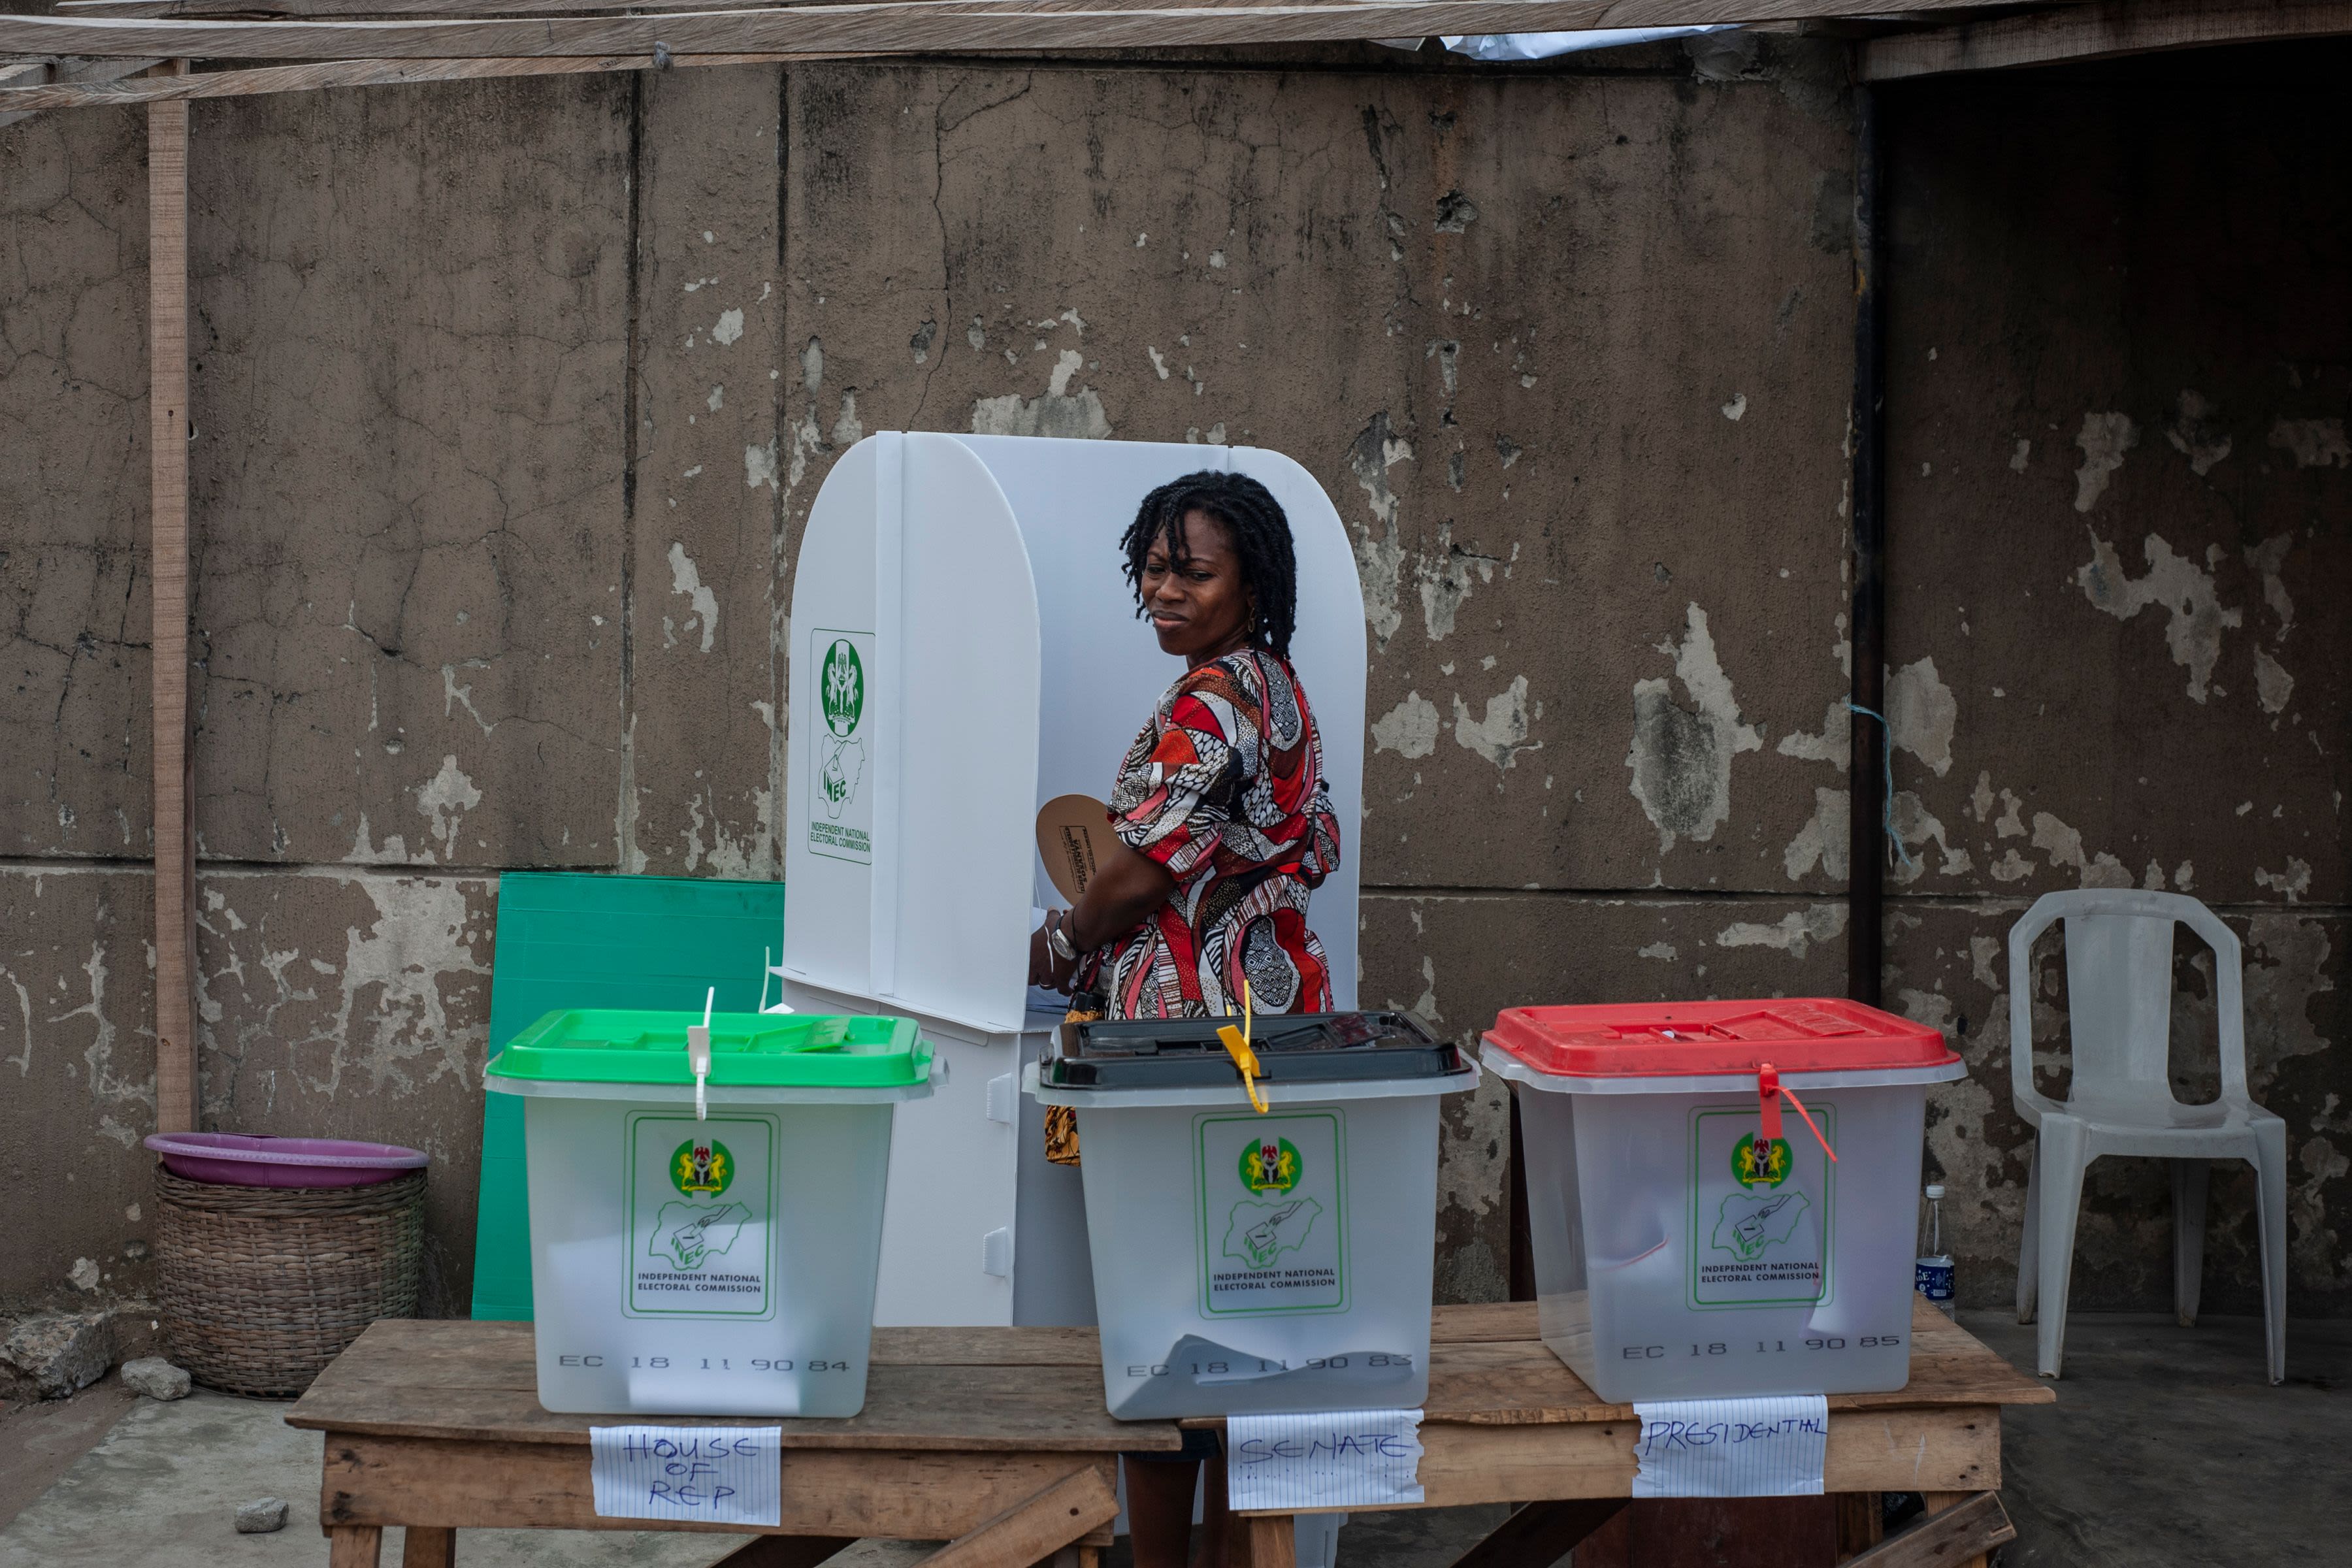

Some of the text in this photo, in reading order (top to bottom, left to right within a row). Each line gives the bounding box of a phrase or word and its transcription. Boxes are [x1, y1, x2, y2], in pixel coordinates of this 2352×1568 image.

[823, 770, 847, 803] INEC
[811, 821, 870, 841] INDEPENDENT NATIONAL
[810, 832, 871, 853] ELECTORAL COMMISSION
[670, 1237, 704, 1266] INEC
[1243, 1236, 1277, 1263] INEC
[1732, 1229, 1765, 1256] INEC
[638, 1273, 761, 1283] INDEPENDENT NATIONAL
[1213, 1268, 1335, 1281] INDEPENDENT NATIONAL
[1701, 1262, 1820, 1273] INDEPENDENT NATIONAL
[1701, 1271, 1820, 1283] ELECTORAL COMMISSION
[638, 1283, 761, 1293] ELECTORAL COMMISSION
[1213, 1278, 1335, 1292] ELECTORAL COMMISSION
[1622, 1335, 1901, 1360] EC 18 11 90 85
[559, 1355, 850, 1372] EC 18 11 90 84
[1126, 1353, 1413, 1377] EC 18 11 90 83
[623, 1433, 761, 1462] HOUSE
[1644, 1417, 1828, 1456] PRESIDENTIAL
[1239, 1432, 1416, 1464] SENATE
[665, 1463, 719, 1482] OF
[649, 1480, 736, 1510] REP
